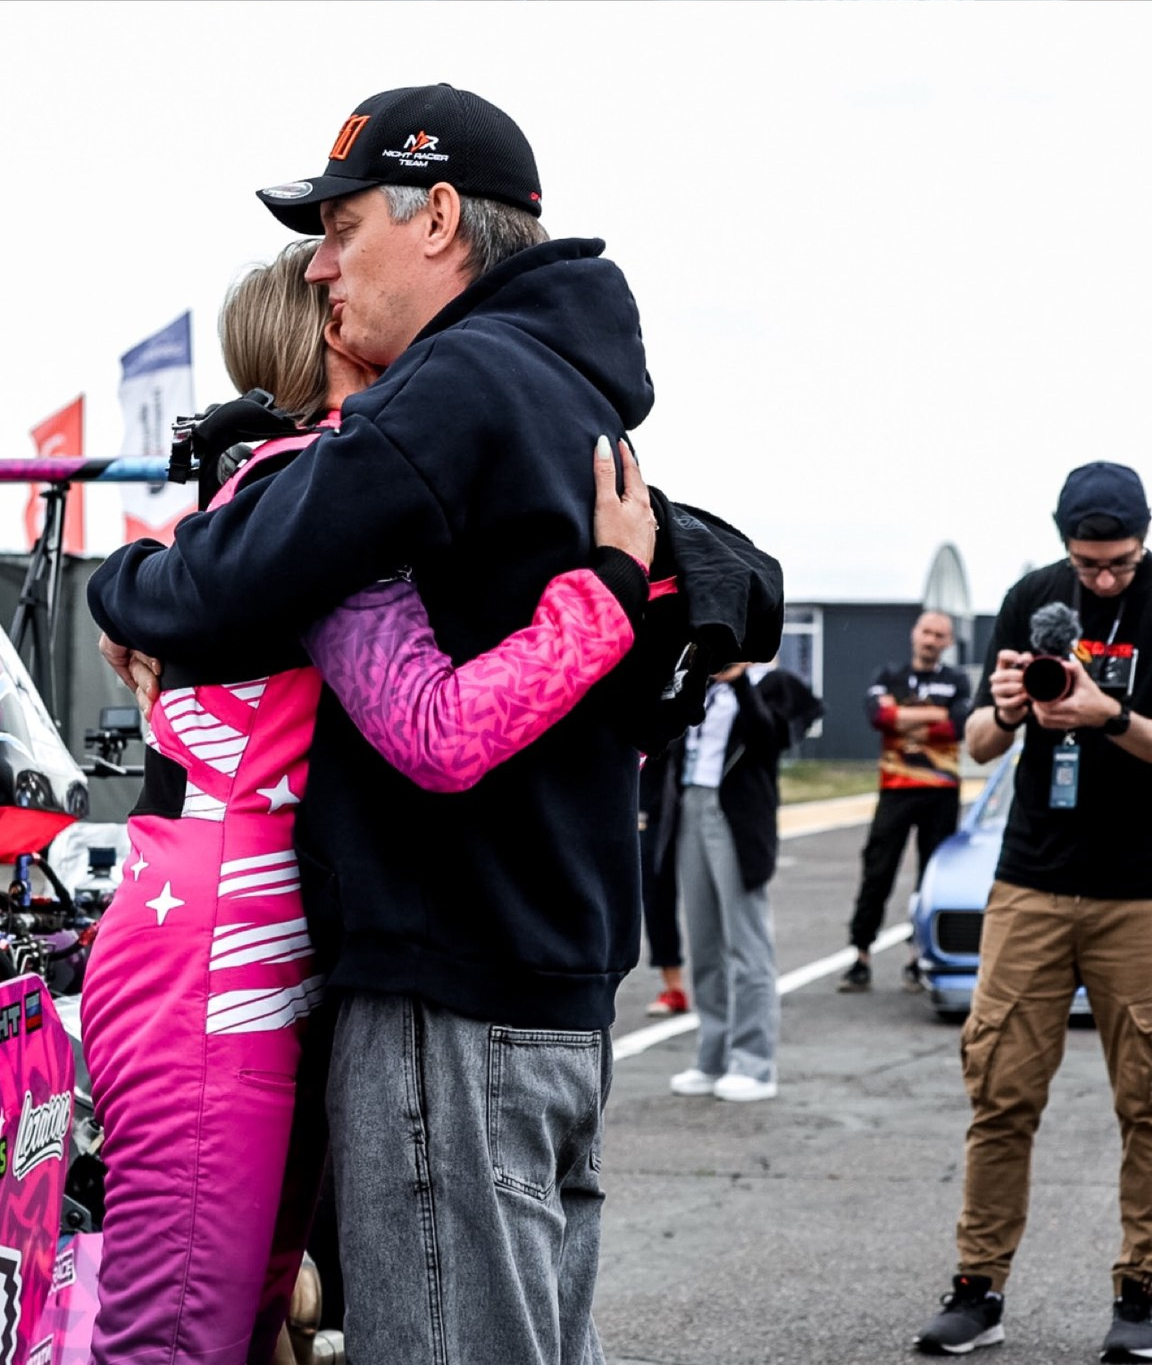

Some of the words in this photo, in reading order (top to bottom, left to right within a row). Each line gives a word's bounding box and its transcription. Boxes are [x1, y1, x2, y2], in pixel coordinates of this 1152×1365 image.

[382, 149, 412, 158] NIGHT
[414, 152, 450, 162] RACER
[399, 158, 429, 167] TEAM
